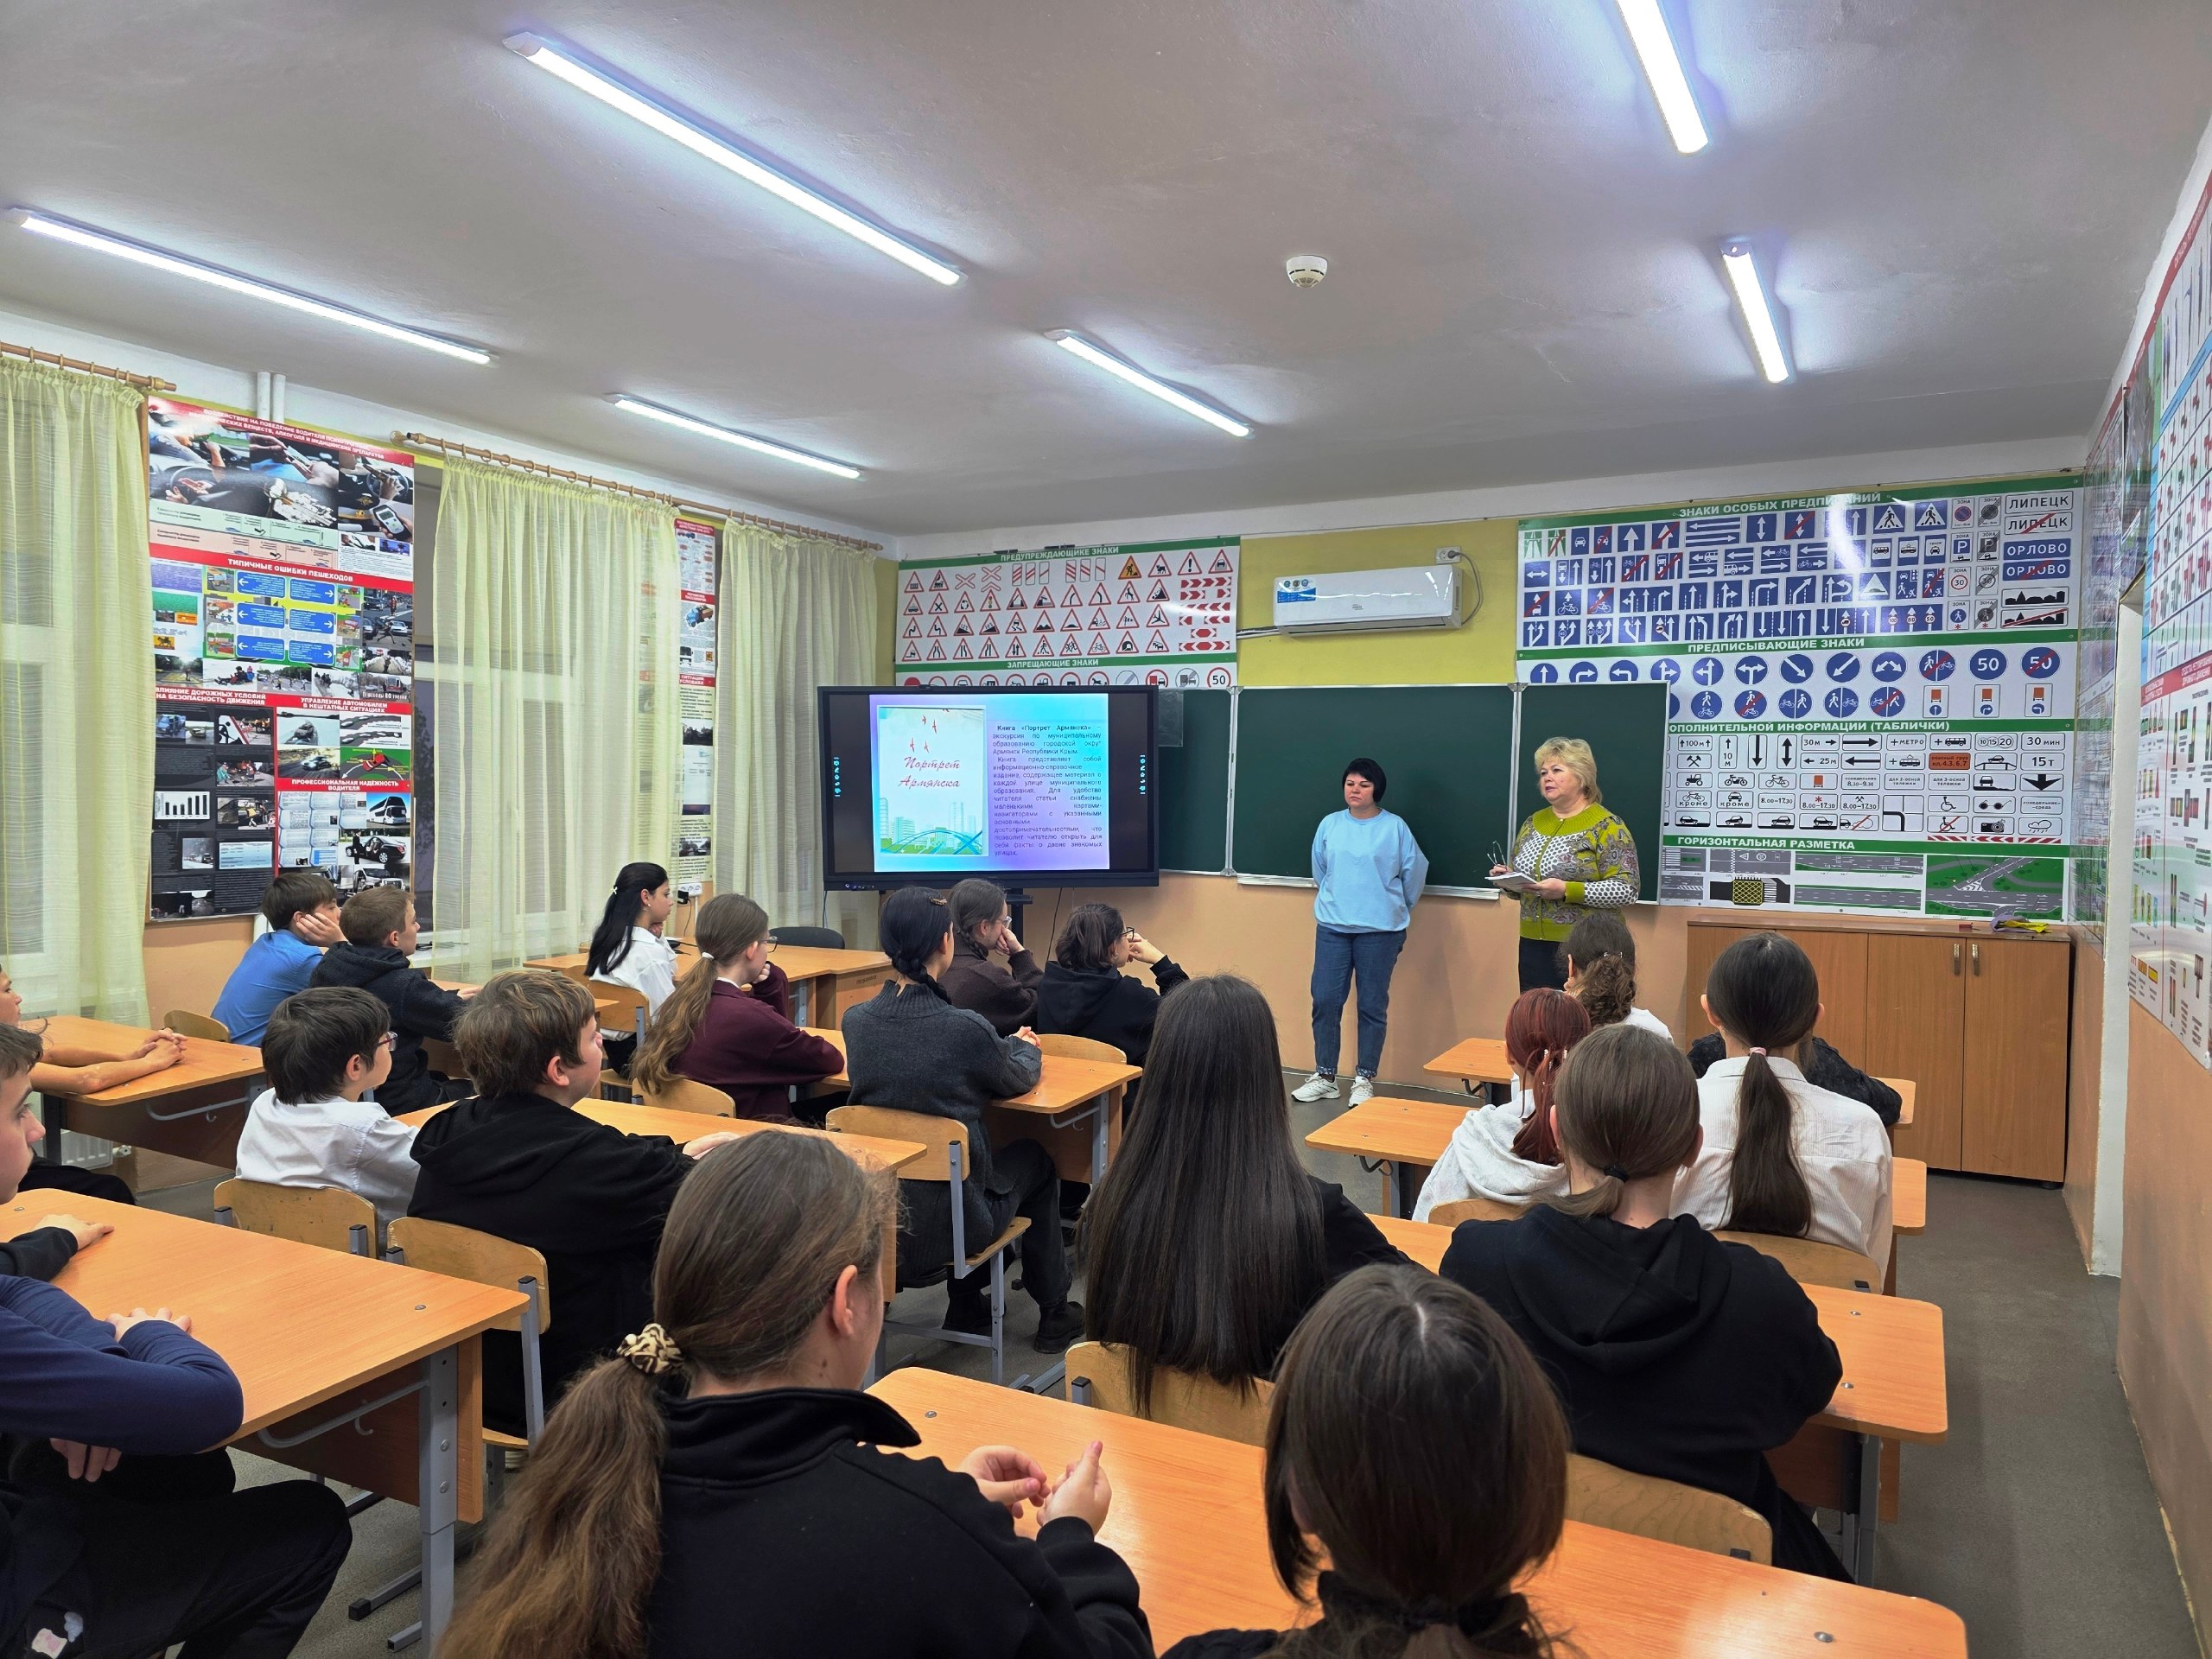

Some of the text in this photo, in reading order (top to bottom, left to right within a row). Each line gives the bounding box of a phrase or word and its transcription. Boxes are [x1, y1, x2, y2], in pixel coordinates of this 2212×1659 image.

[276, 430, 304, 441] АЛКОГОЛЯ
[296, 429, 325, 439] ВОДИТЕЛЯ
[1679, 492, 1880, 518] ЗНАКИ ОСОБЫХ ПРЕДПИАНИЙ
[2010, 496, 2069, 509] ЛИПЕЦК
[2007, 543, 2067, 556] ОРЛОВО
[228, 558, 353, 582] ТИПИЧНЫЕ ОШИБКИ ПЕШЕХОДОВ
[1688, 639, 1865, 653] ПРЕДПИСЫВАЮЩИЕ ЗНАКИ
[1978, 658, 1999, 671] 50
[1213, 676, 1225, 684] 50
[1669, 721, 1949, 732] ОПОЛНИТЕЛЬНОЙ ИНФОРМАЦИИ (ТАБЛИЧКИ)
[904, 756, 960, 772] Портрет
[2032, 757, 2046, 766] 15
[898, 775, 959, 790] Армянска
[1677, 836, 1855, 849] ГОРИЗОНТАЛЬНАЯ РАЗМЕТКА
